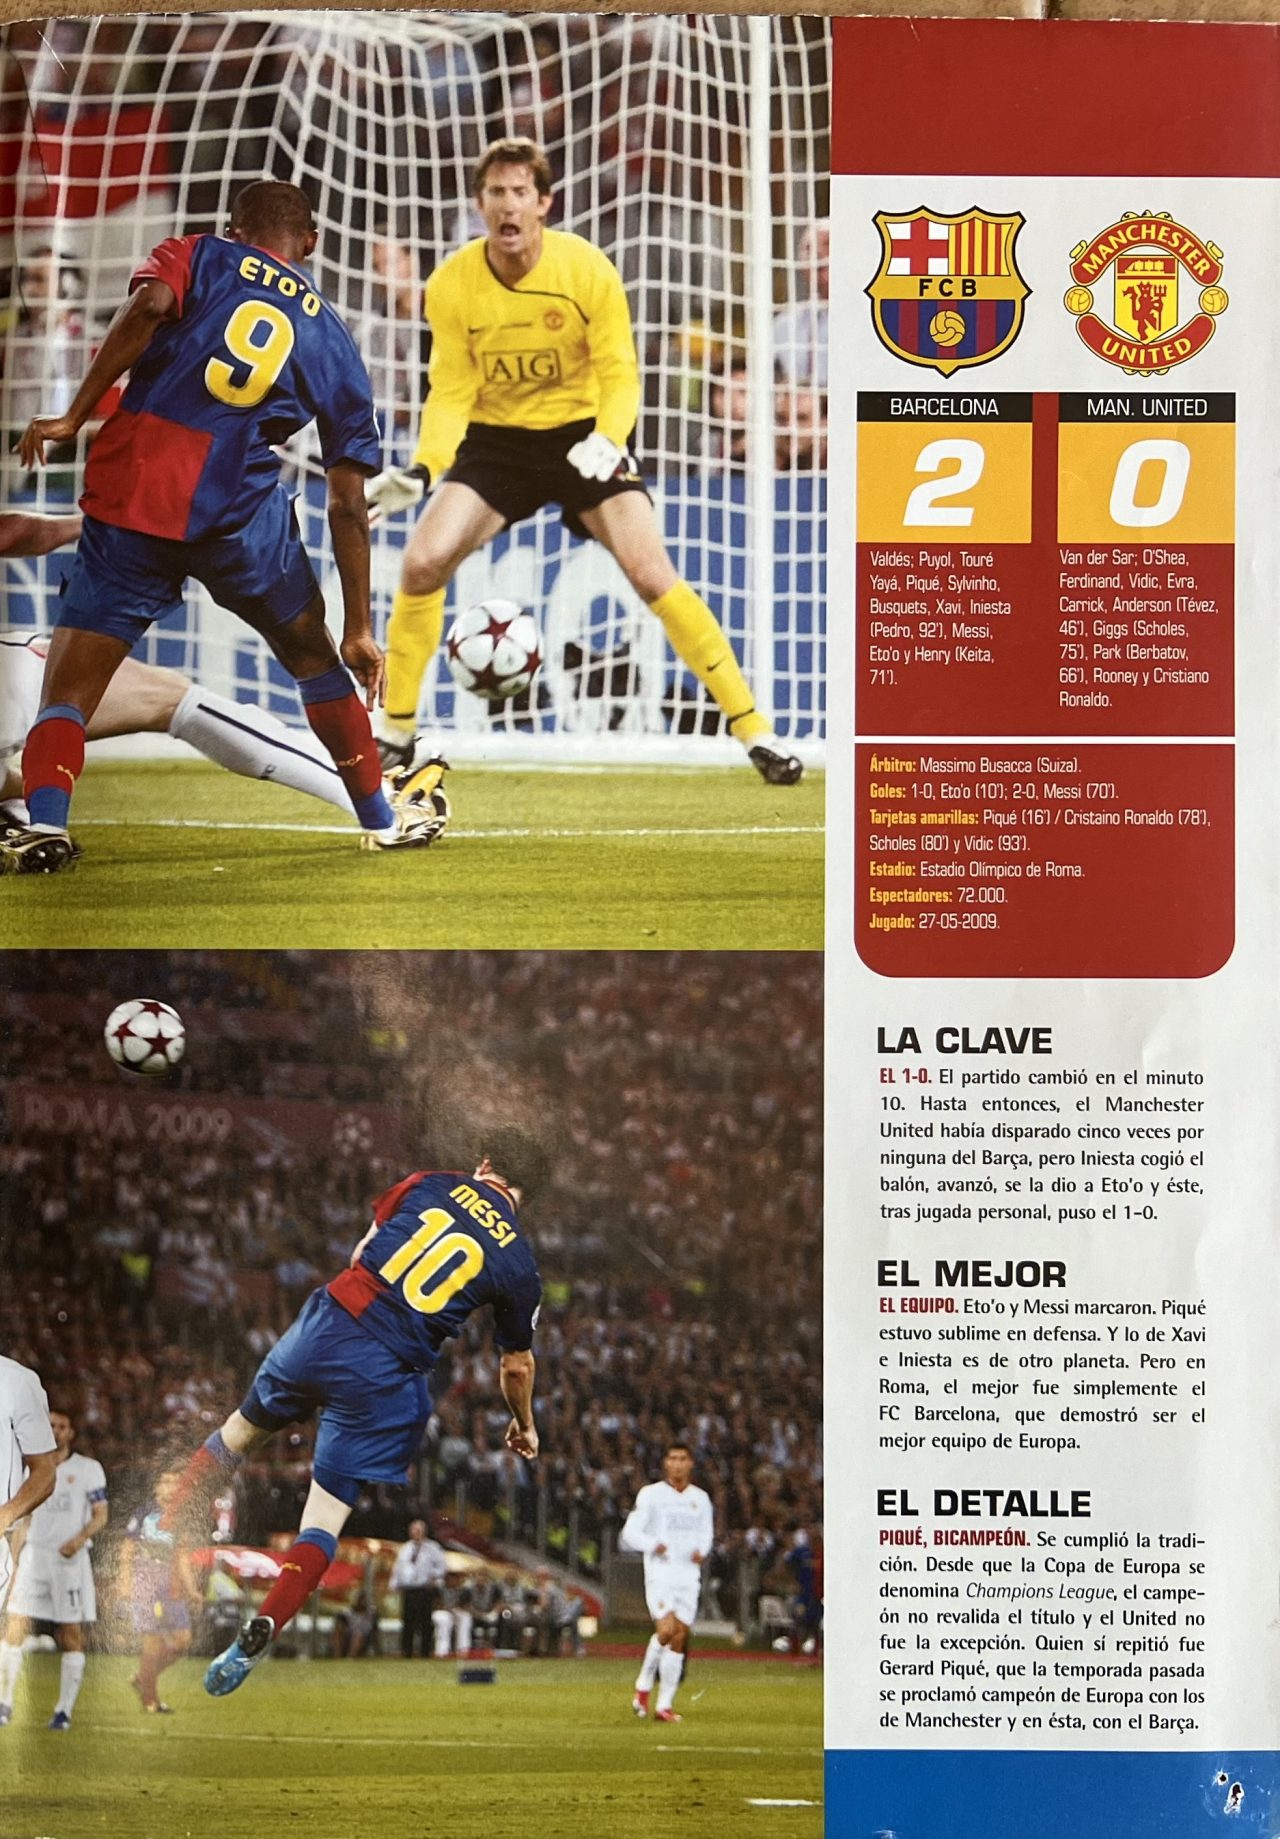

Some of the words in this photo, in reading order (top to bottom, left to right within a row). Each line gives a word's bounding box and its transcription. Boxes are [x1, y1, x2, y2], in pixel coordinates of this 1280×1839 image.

[1081, 223, 1211, 278] MANCHESTER
[238, 255, 321, 317] ETO'O
[204, 299, 295, 408] 9
[1100, 336, 1194, 365] UNITED
[490, 353, 555, 380] AIG
[890, 397, 999, 416] BARCELONA
[1087, 398, 1135, 416] MAN.
[1142, 398, 1208, 417] UNITED
[902, 438, 986, 527] 2
[1109, 439, 1192, 528] 0
[870, 550, 914, 569] Valdés;
[919, 550, 955, 571] Puyol,
[959, 551, 994, 568] Touré
[1059, 549, 1083, 565] Van
[1086, 549, 1109, 565] der
[1112, 548, 1138, 566] Sar;
[1142, 548, 1189, 567] O'Shea,
[869, 753, 917, 773] Árbitro:
[920, 756, 976, 773] Massimo
[980, 756, 1032, 773] Busacca
[1036, 756, 1082, 773] (Suiza).
[869, 913, 915, 932] Jugado:
[918, 912, 1000, 930] 27-05-2009.
[877, 1026, 922, 1054] LA
[935, 1026, 1053, 1055] CLAVE
[879, 1067, 897, 1084] EL
[902, 1067, 933, 1084] 1-0.
[939, 1068, 954, 1084] El
[961, 1068, 1021, 1089] partido
[1028, 1068, 1088, 1085] cambió
[1095, 1073, 1116, 1085] en
[1123, 1069, 1138, 1085] el
[1146, 1069, 1204, 1085] minuto
[23, 1093, 137, 1139] ROMA
[144, 1102, 234, 1144] 2009
[448, 1183, 518, 1249] MESSI
[378, 1207, 485, 1315] 10
[877, 1259, 920, 1288] EL
[935, 1259, 1067, 1288] MEJOR
[877, 1489, 920, 1517] EL
[933, 1489, 1092, 1518] DETALLE
[879, 1525, 928, 1549] PIQUÉ,
[933, 1526, 1031, 1547] BICAMPEÓN.
[1036, 1530, 1057, 1547] Se
[1063, 1531, 1129, 1552] cumplió
[1136, 1532, 1151, 1548] la
[1158, 1532, 1206, 1549] tradi-
